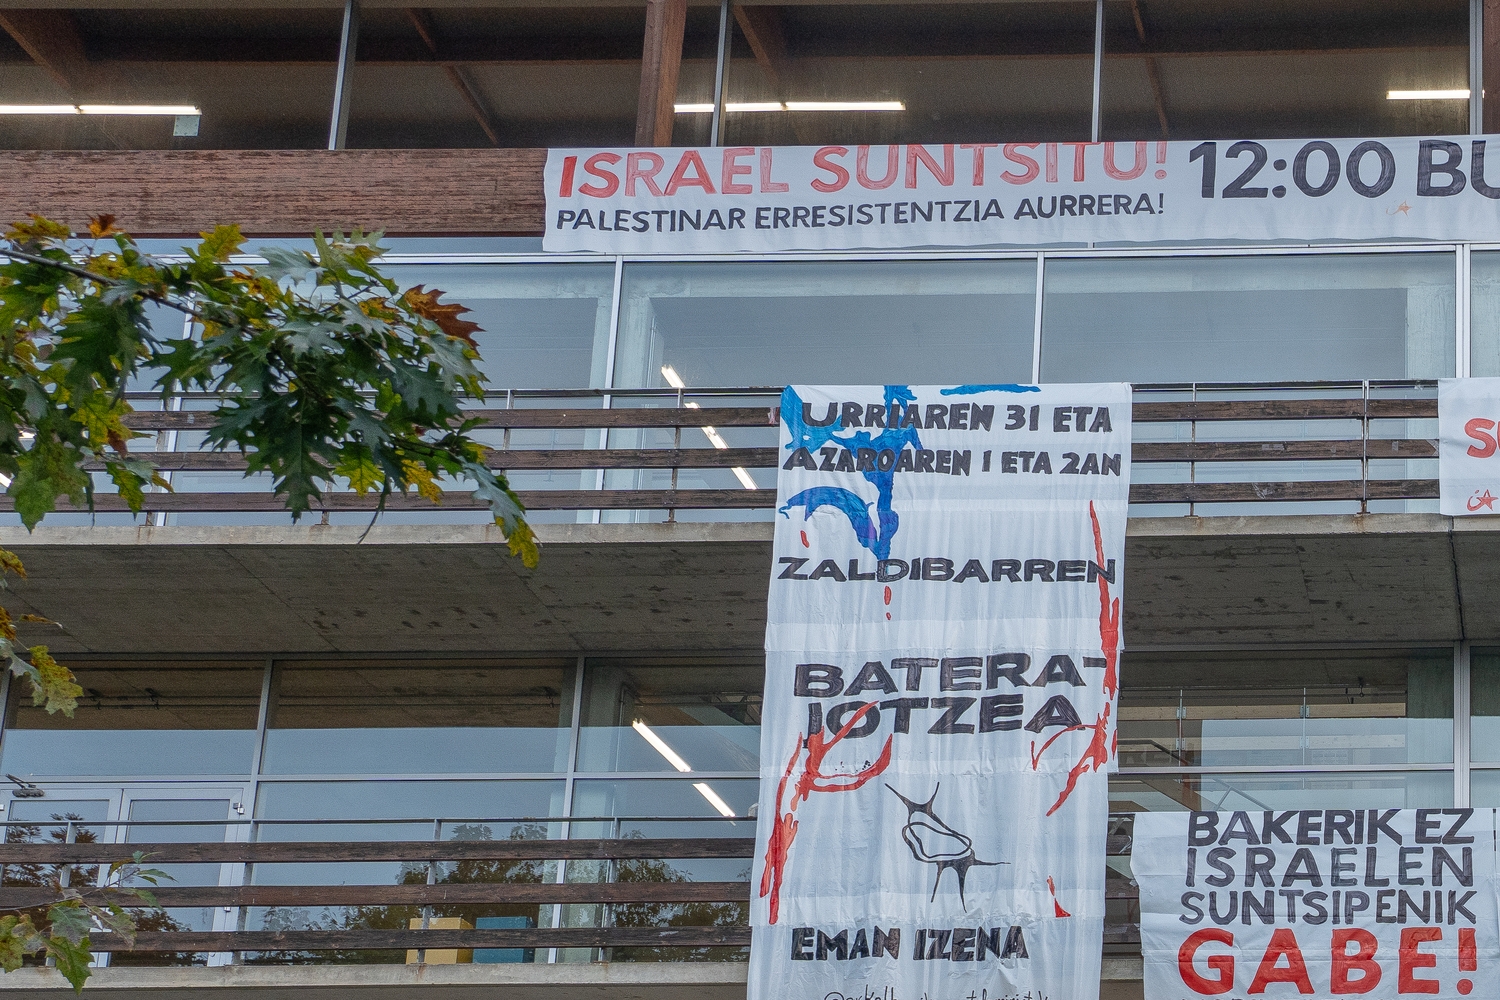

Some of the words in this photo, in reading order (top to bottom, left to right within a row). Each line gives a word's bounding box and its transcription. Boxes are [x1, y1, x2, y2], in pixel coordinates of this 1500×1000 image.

[559, 148, 789, 198] ISRAEL
[810, 141, 1168, 194] SUNTSITU!
[1189, 140, 1397, 200] 12:00
[556, 207, 746, 233] PALESTINAR
[754, 198, 1005, 230] ERRESISTENTZIA
[1014, 193, 1165, 221] AURRERA!
[802, 402, 995, 431] URRIAREN
[1004, 404, 1040, 432] 31
[1053, 406, 1112, 433] ETA
[782, 446, 971, 476] AZAROAREN
[981, 450, 991, 472] 1
[1001, 451, 1053, 474] ETA
[1059, 452, 1122, 477] 2AN
[777, 556, 1116, 584] ZALDIBARREN
[794, 654, 1108, 698] BATERA-
[802, 694, 1085, 749] JOTZEA
[1187, 809, 1403, 846] BAKERIK
[1414, 808, 1475, 844] EZ
[1185, 846, 1475, 888] ISRAELEN
[1179, 889, 1478, 925] SUNTSIPENIK
[790, 925, 900, 961] EMAN
[913, 926, 1030, 962] IZENA
[1177, 927, 1477, 996] GABE!
